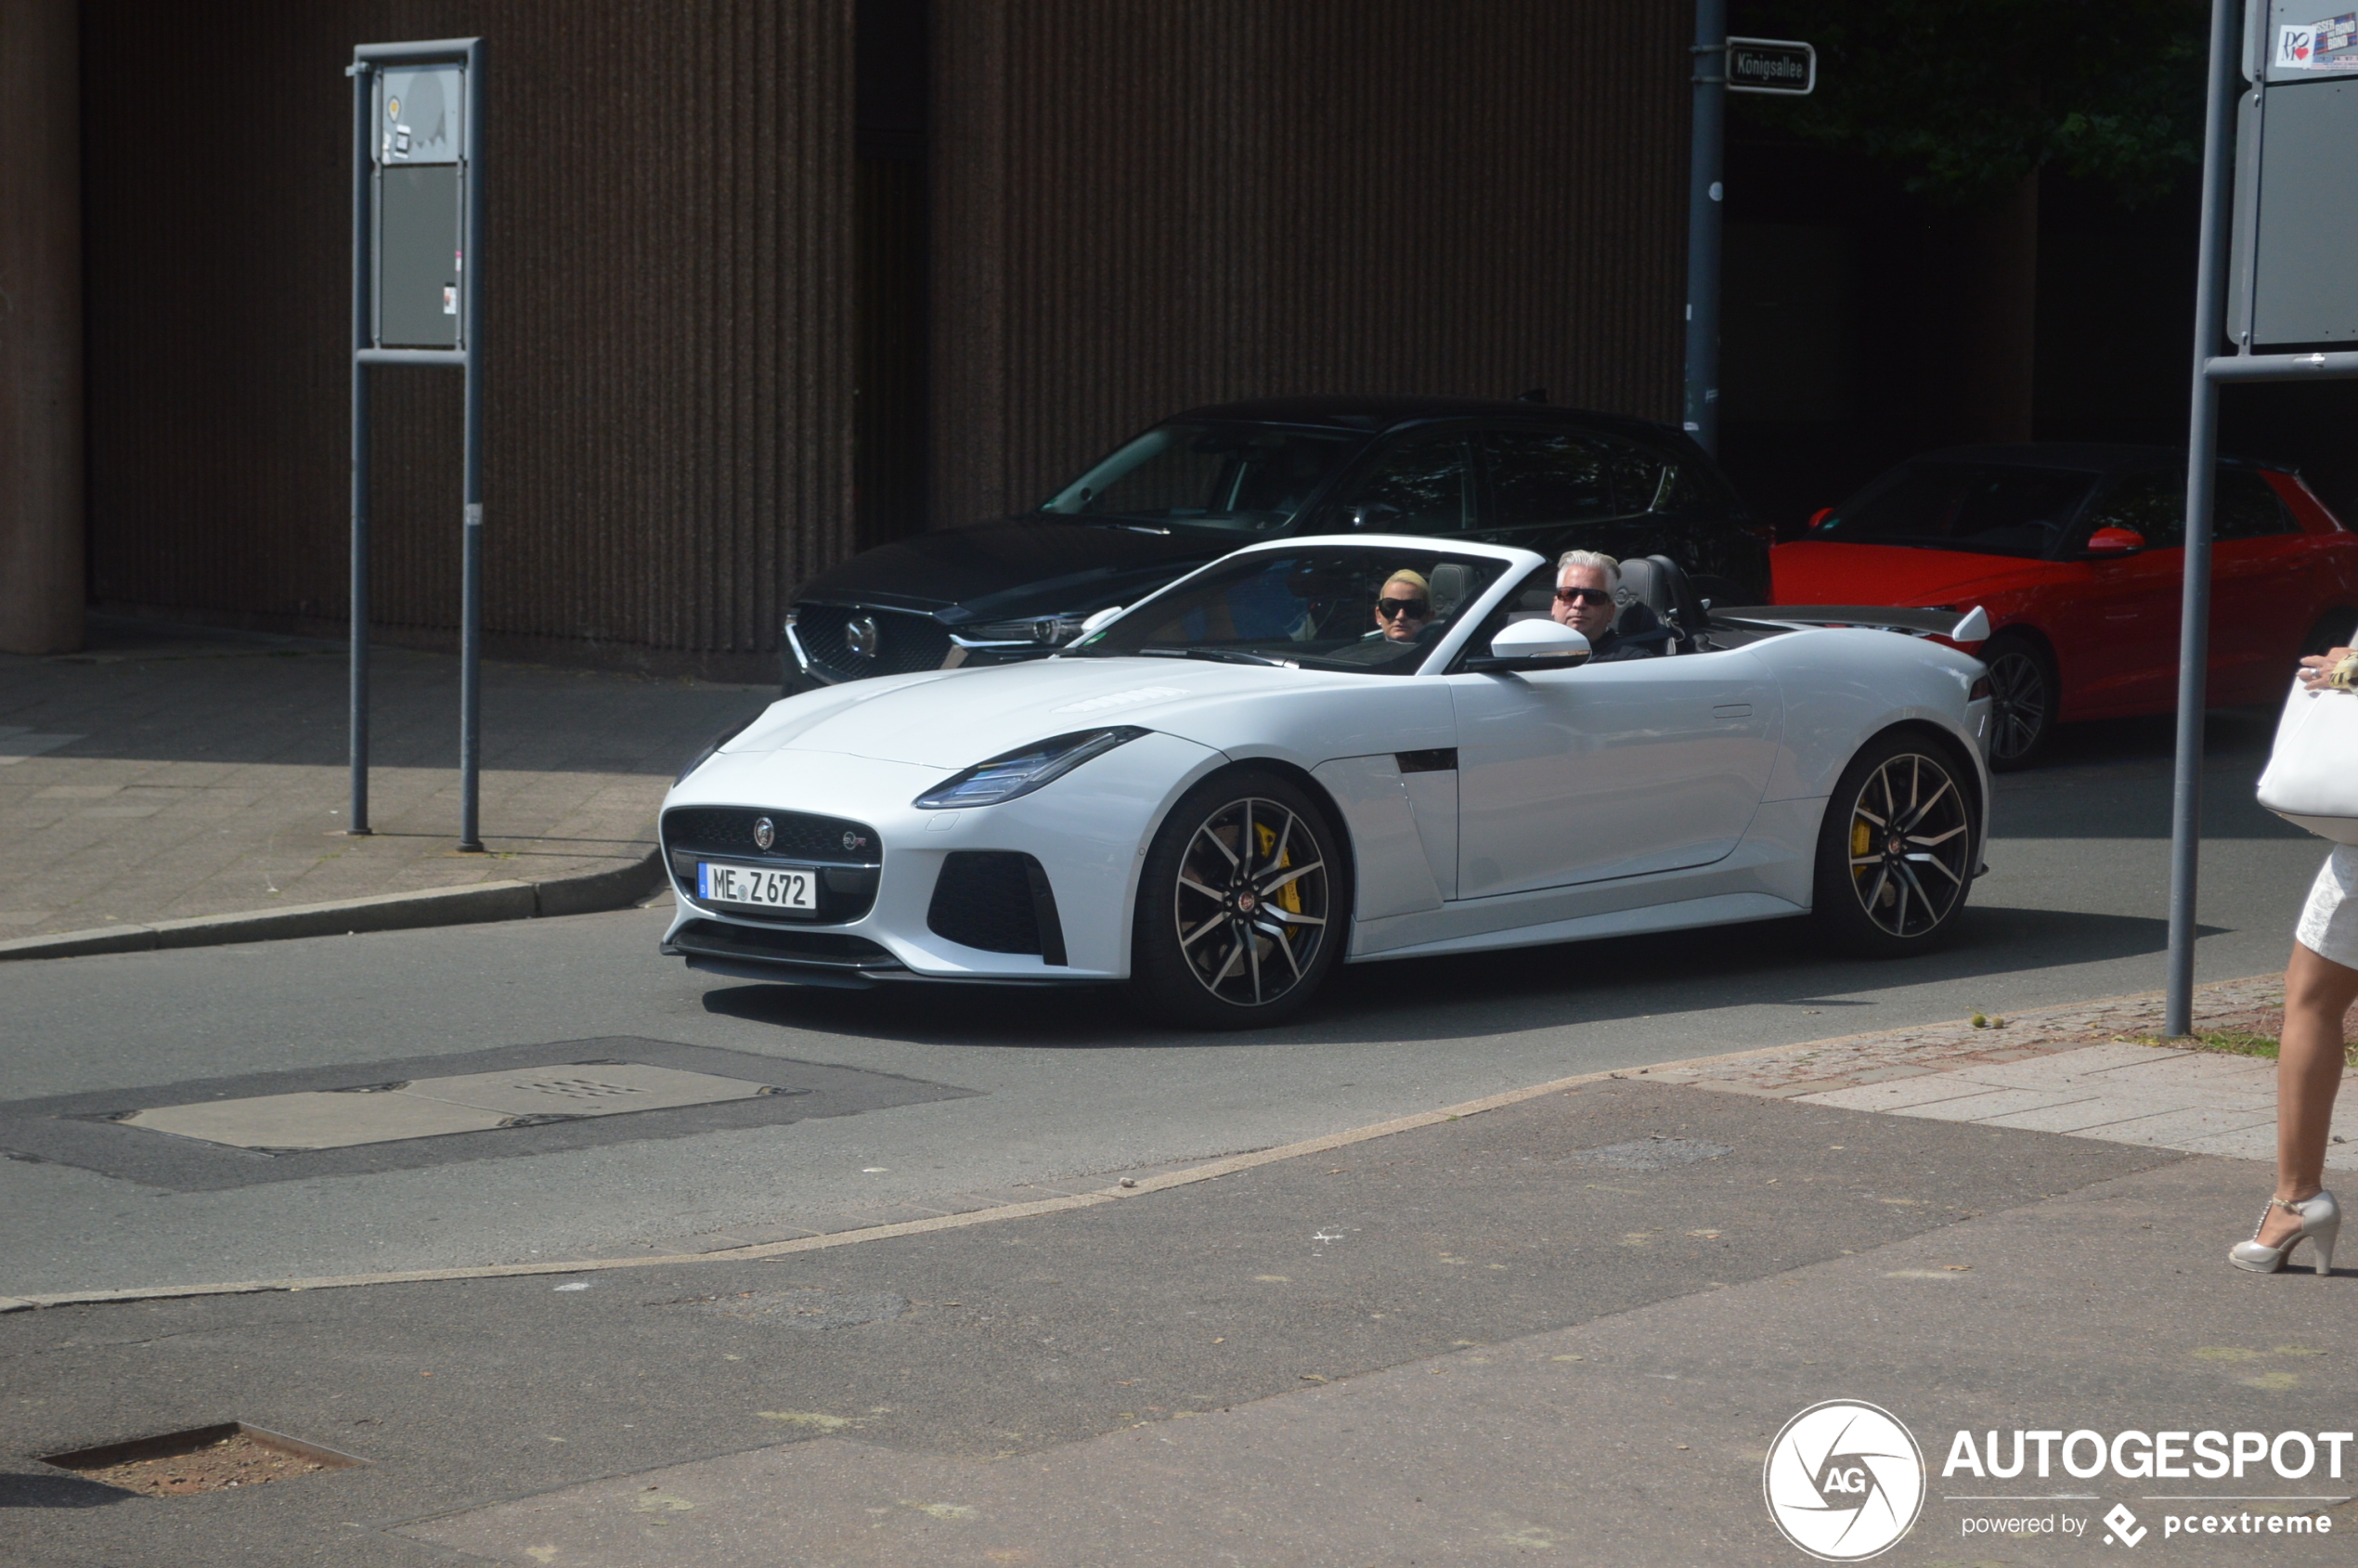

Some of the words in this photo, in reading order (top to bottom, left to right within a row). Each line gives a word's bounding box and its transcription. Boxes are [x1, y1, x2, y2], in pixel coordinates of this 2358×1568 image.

[2327, 35, 2349, 50] BAND
[1738, 53, 1803, 80] Königsallee
[713, 868, 737, 900] ME
[750, 872, 762, 901] Z
[767, 874, 806, 905] 672
